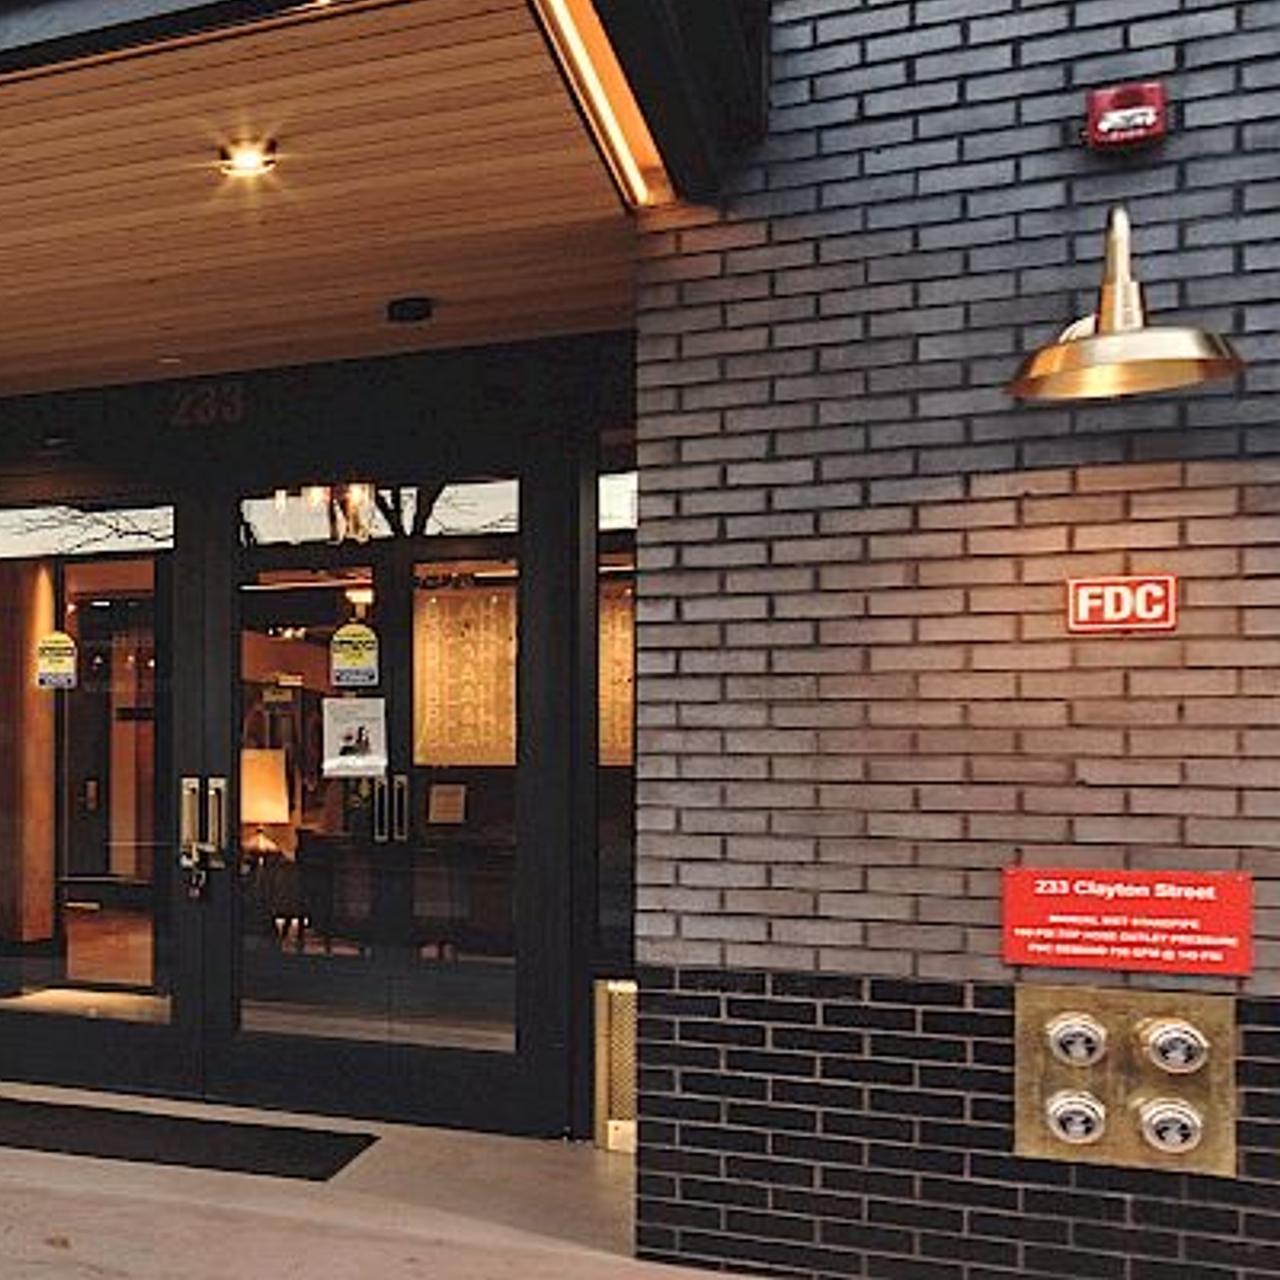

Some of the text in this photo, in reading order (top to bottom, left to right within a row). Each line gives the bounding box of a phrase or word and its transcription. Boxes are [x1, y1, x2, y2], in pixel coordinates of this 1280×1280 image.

[1078, 583, 1166, 622] FDC
[1034, 880, 1217, 900] 233 Clayton Street
